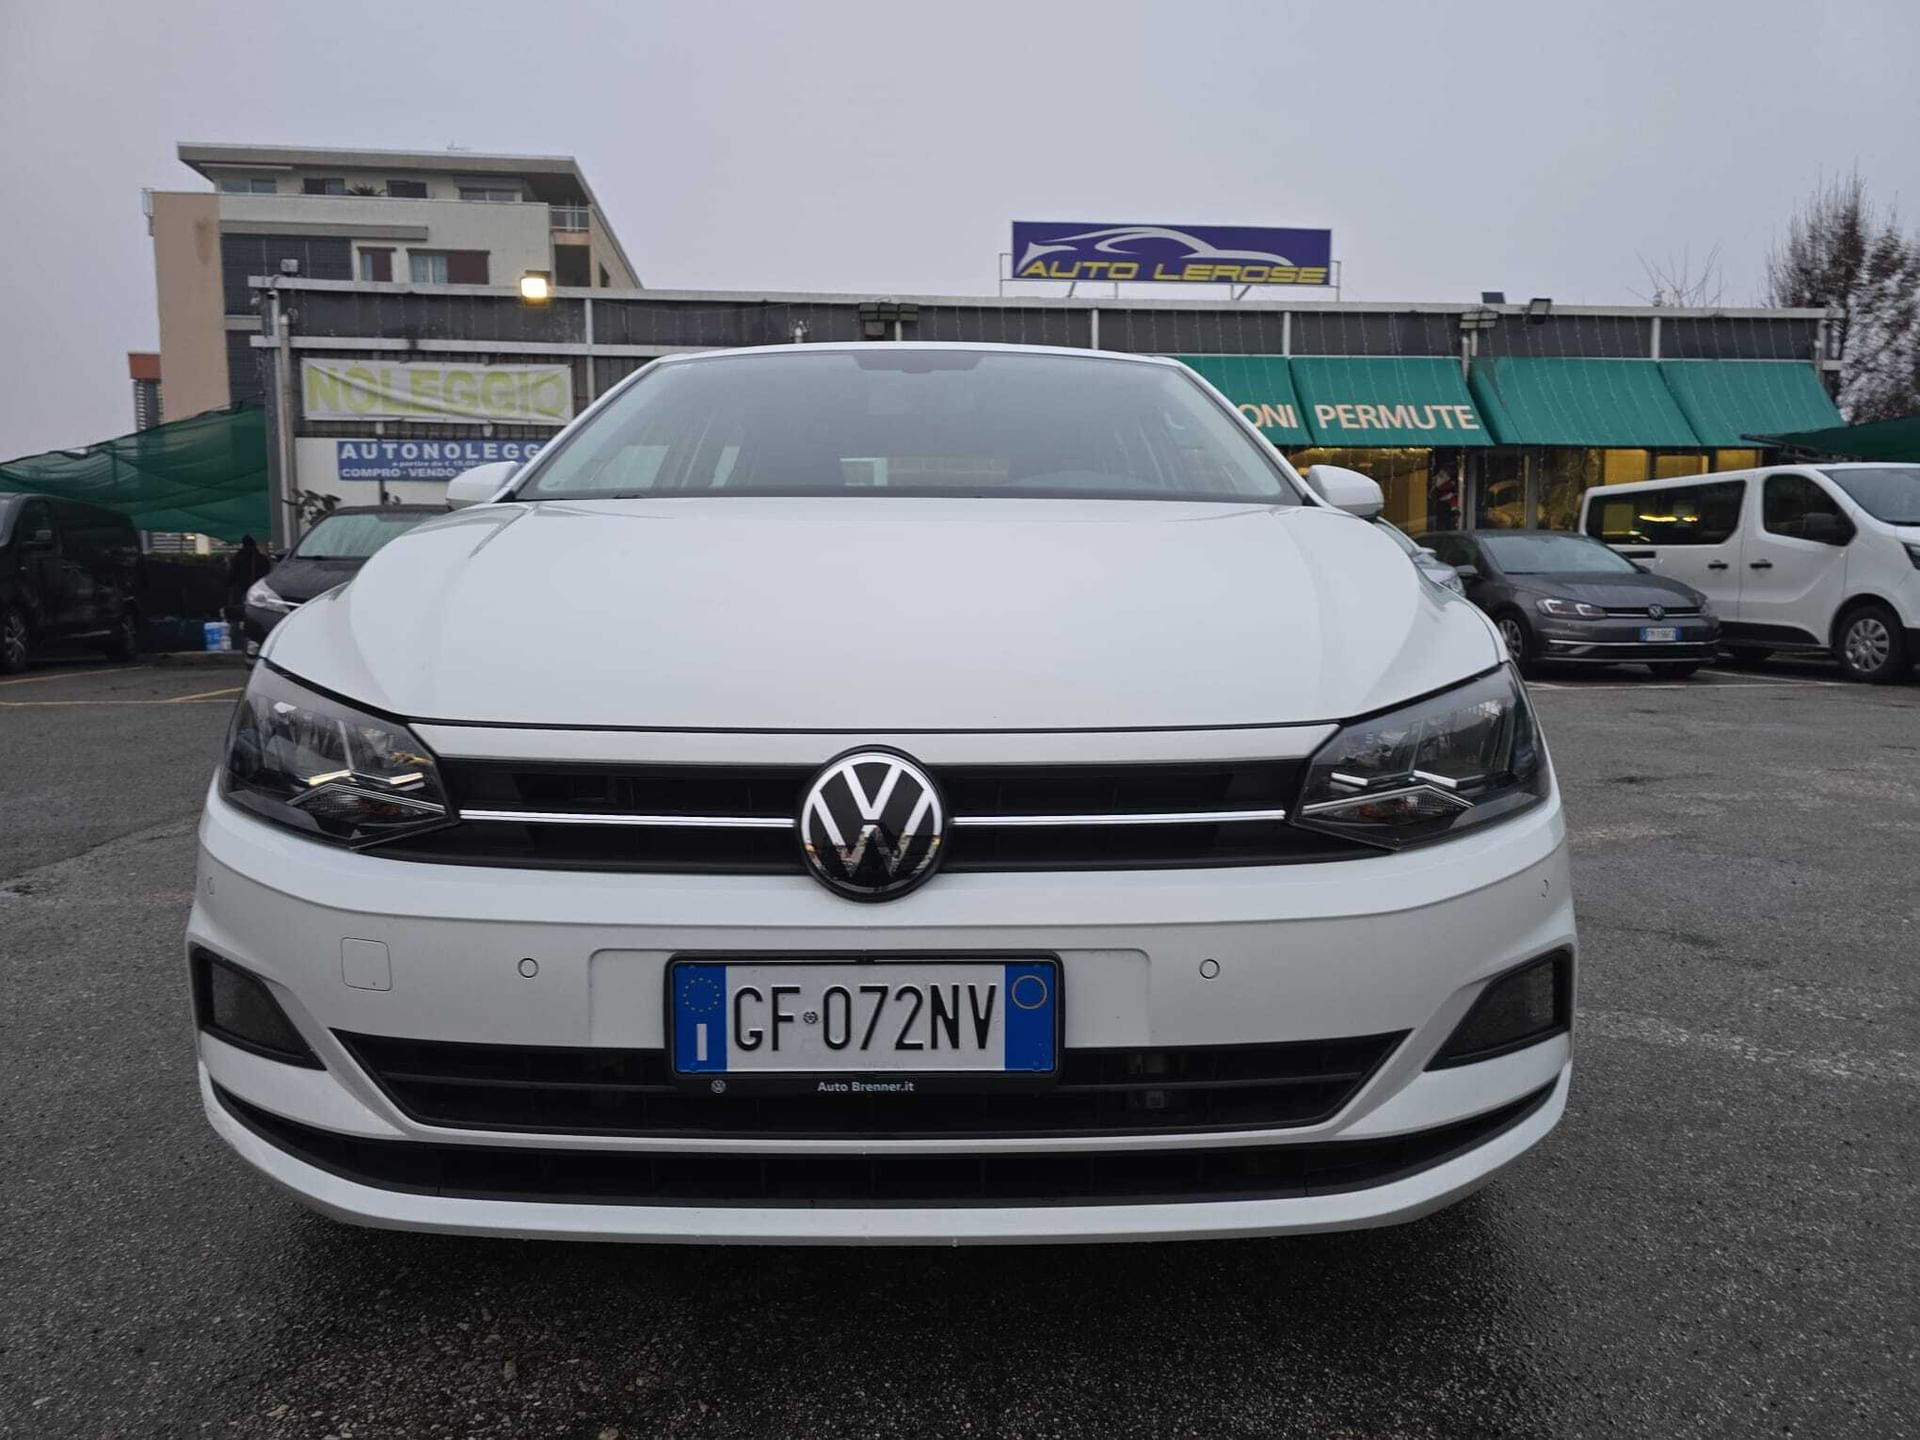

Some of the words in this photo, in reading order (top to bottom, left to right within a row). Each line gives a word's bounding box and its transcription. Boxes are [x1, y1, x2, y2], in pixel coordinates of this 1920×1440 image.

[1021, 260, 1140, 279] AUTO
[1153, 263, 1329, 284] LEROSE
[306, 366, 567, 417] NOLEGGIO
[1314, 404, 1480, 430] PERMUTE
[342, 468, 401, 477] COMPRO
[408, 468, 456, 477] VENDO
[817, 1081, 848, 1092] Auto
[852, 1081, 914, 1092] Brenner.it
